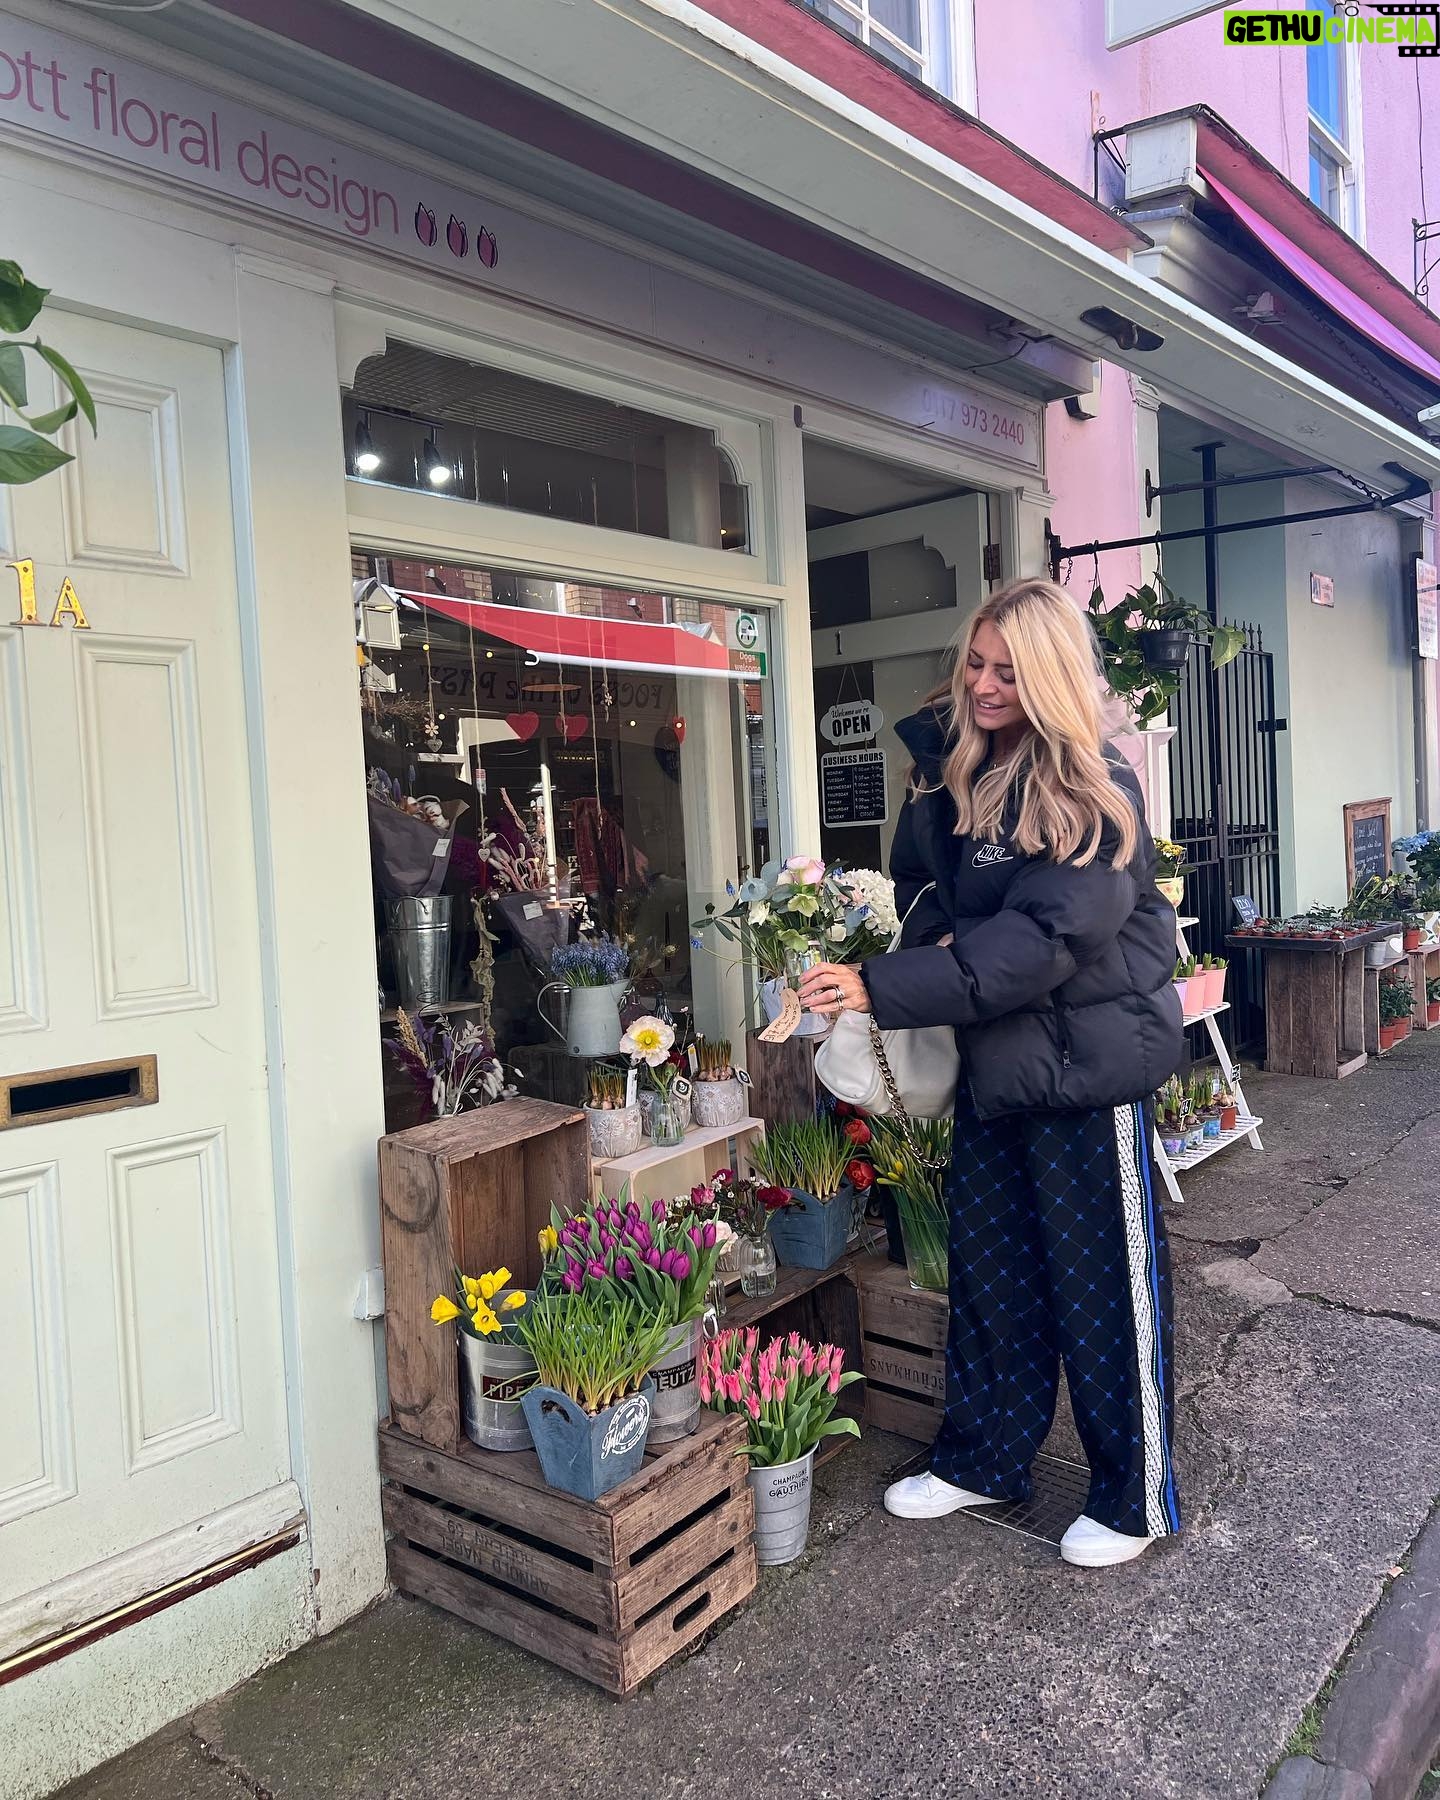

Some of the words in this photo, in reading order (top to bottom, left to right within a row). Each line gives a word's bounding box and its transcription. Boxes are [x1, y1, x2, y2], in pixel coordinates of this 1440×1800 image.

[83, 67, 220, 172] floral
[237, 131, 399, 236] design
[961, 402, 988, 433] 973
[992, 414, 1025, 446] 2440
[5, 557, 91, 629] 1A
[734, 663, 762, 673] welcome
[739, 651, 756, 663] Dogs
[832, 714, 871, 738] OPEN
[823, 754, 858, 766] BUSINESS
[859, 752, 884, 763] HOURS
[977, 844, 1006, 861] NIKE
[655, 1364, 695, 1391] EUTZ
[772, 1466, 808, 1486] CHAMPAGNE
